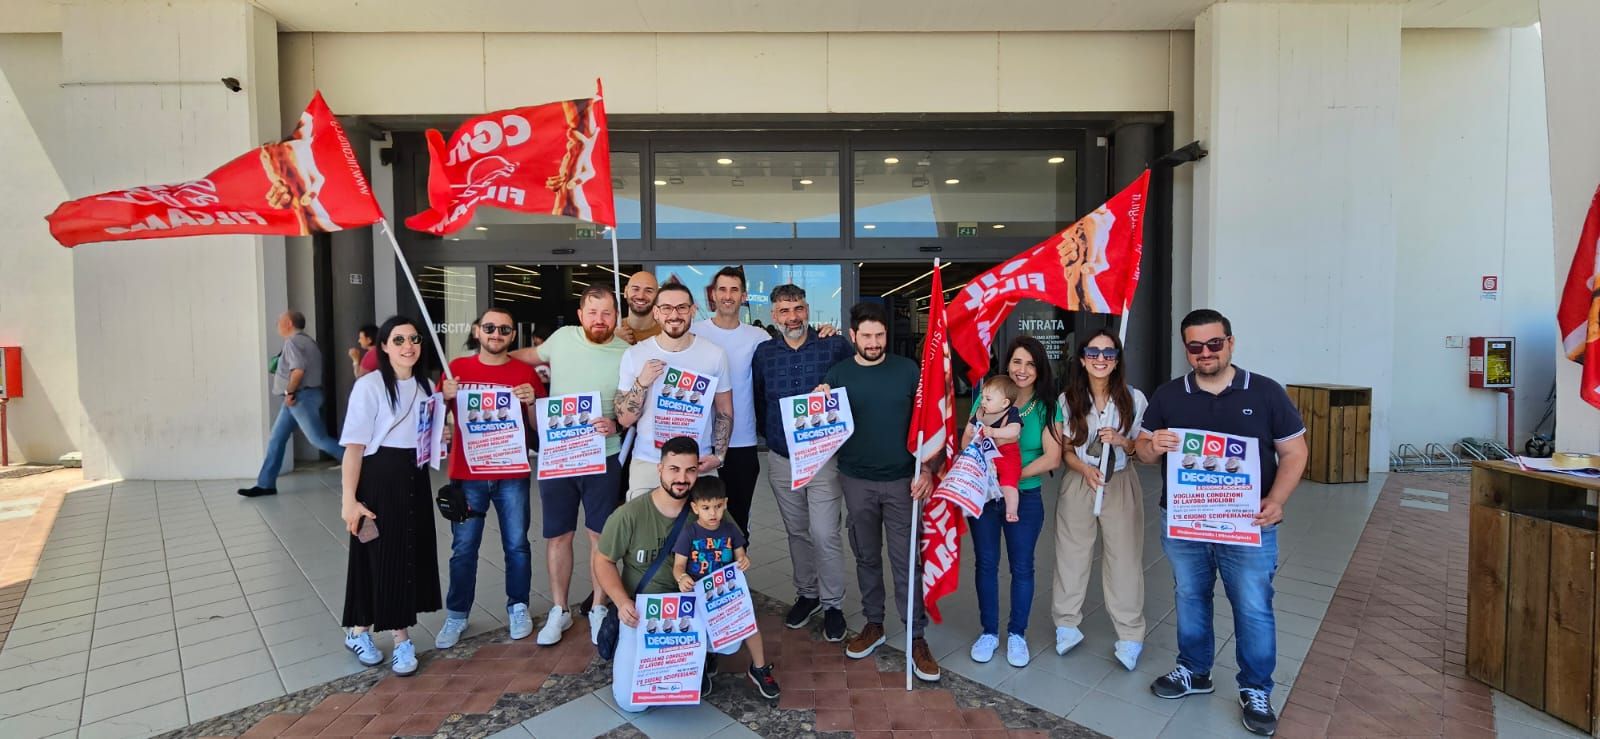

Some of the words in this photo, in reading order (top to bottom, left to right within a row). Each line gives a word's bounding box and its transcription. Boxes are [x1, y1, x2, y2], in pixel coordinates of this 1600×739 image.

[432, 322, 471, 334] USCITA
[1018, 319, 1064, 330] ENTRATA
[692, 537, 733, 550] TRAVEL
